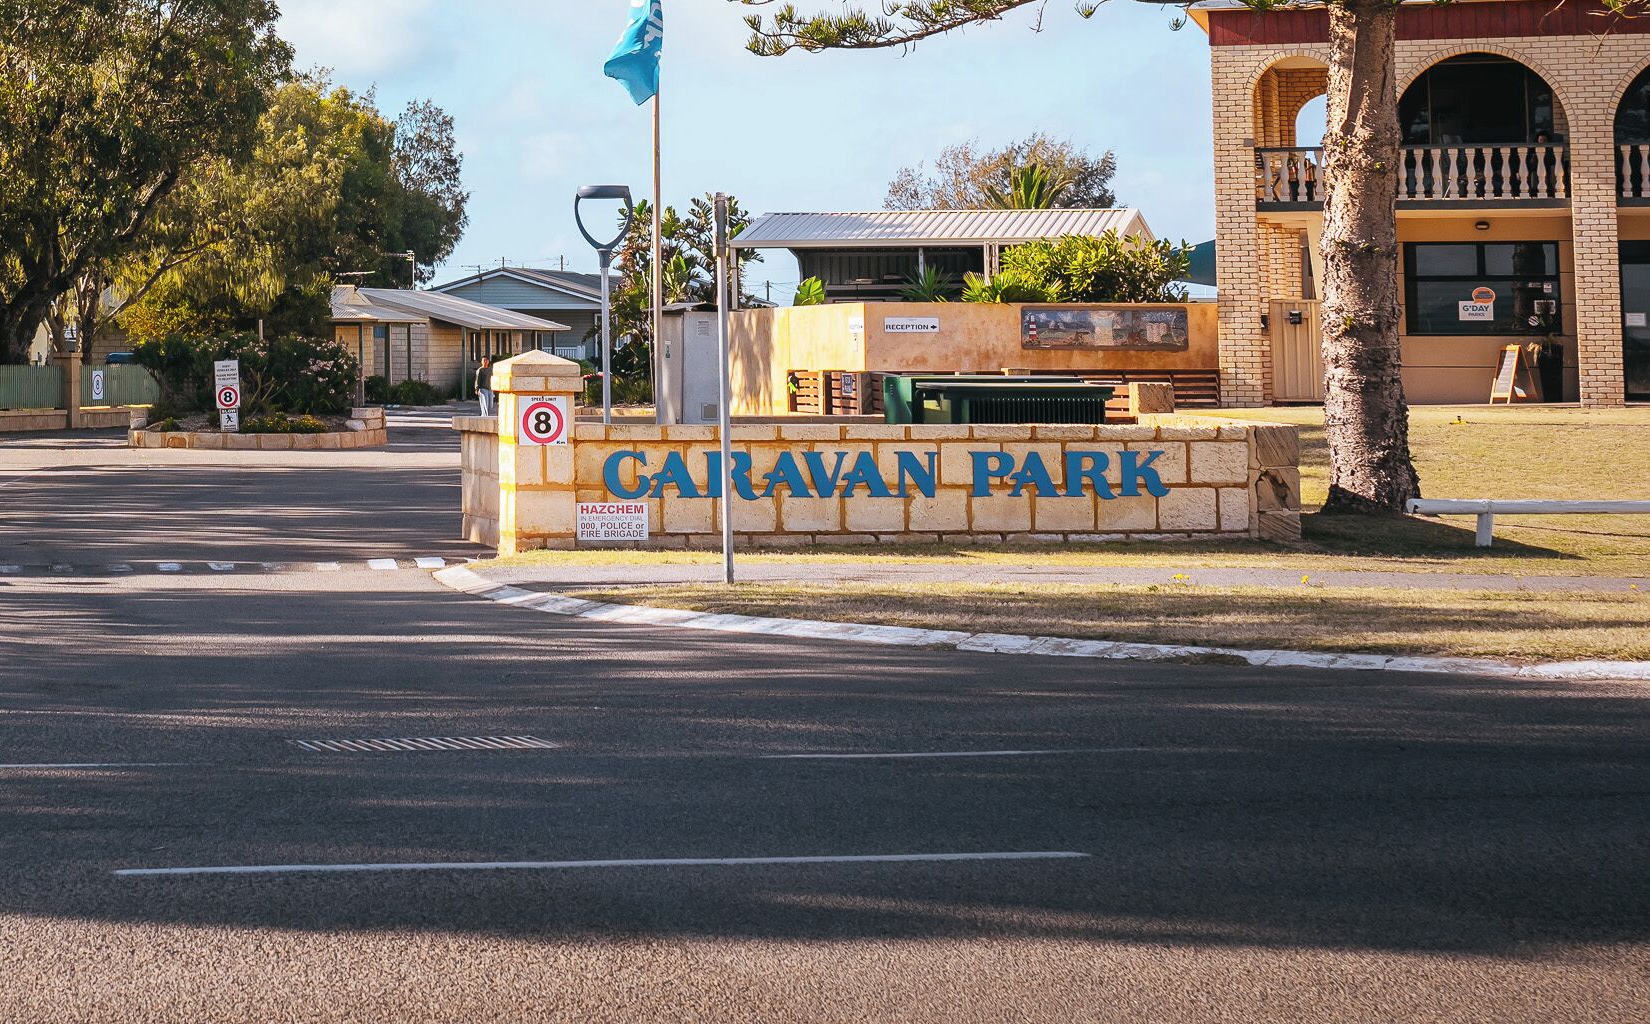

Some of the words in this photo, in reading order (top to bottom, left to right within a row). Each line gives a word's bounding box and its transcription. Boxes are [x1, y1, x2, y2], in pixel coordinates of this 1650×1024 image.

[1462, 304, 1490, 312] G'DAY
[223, 391, 233, 403] 8
[534, 411, 552, 434] 8
[603, 451, 936, 501] CARAVAN
[971, 451, 1169, 500] PARK
[580, 505, 644, 514] HAZCHEM
[580, 522, 598, 530] 000,
